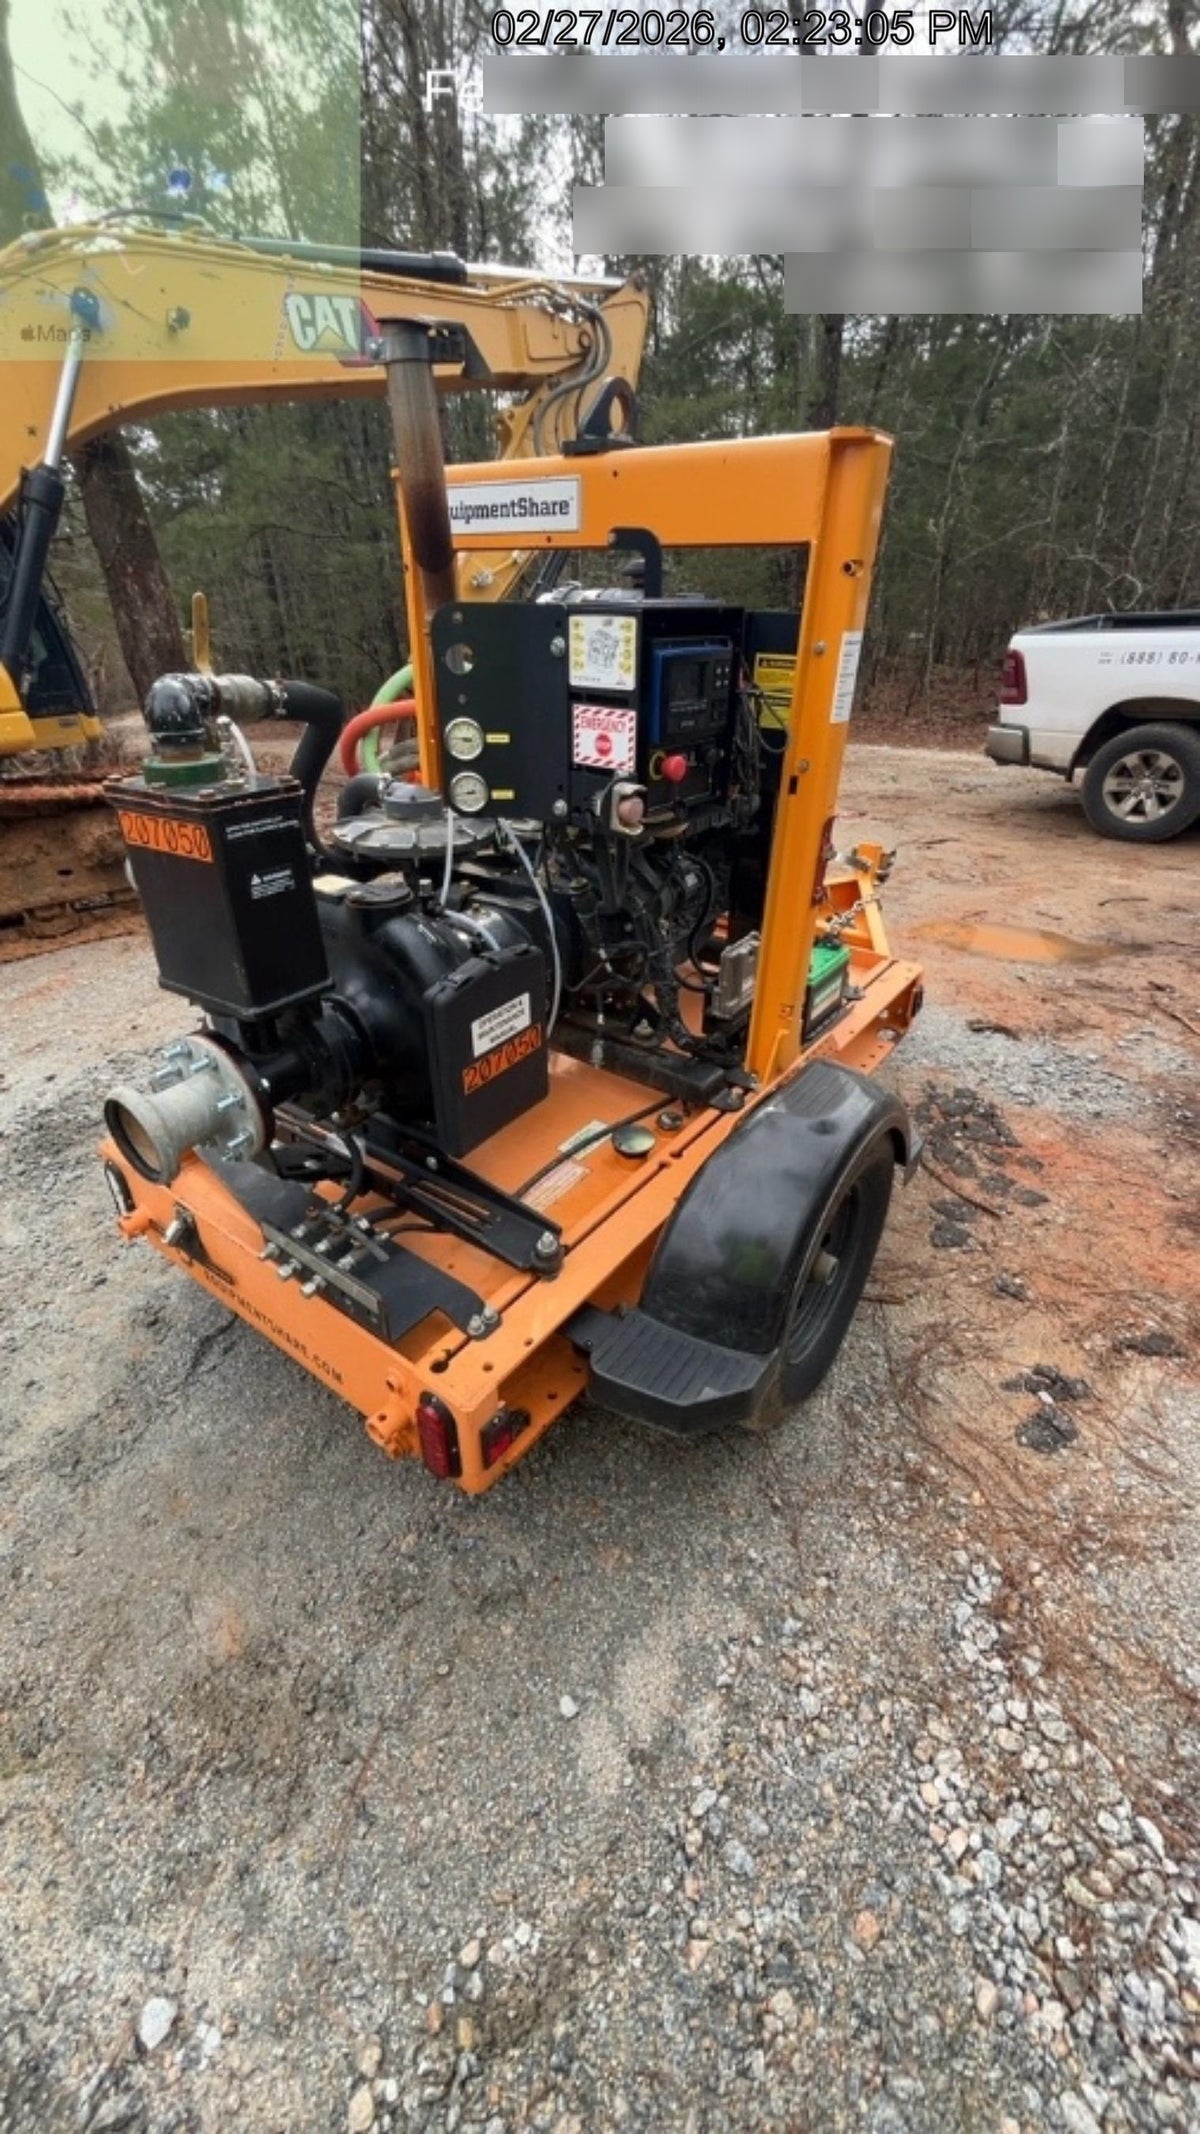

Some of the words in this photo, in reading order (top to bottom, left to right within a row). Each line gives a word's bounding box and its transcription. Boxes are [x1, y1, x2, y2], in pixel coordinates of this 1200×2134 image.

[285, 294, 359, 350] CAT
[449, 497, 571, 525] uipmentShare
[122, 812, 211, 859] 207050
[464, 1024, 540, 1093] 207050
